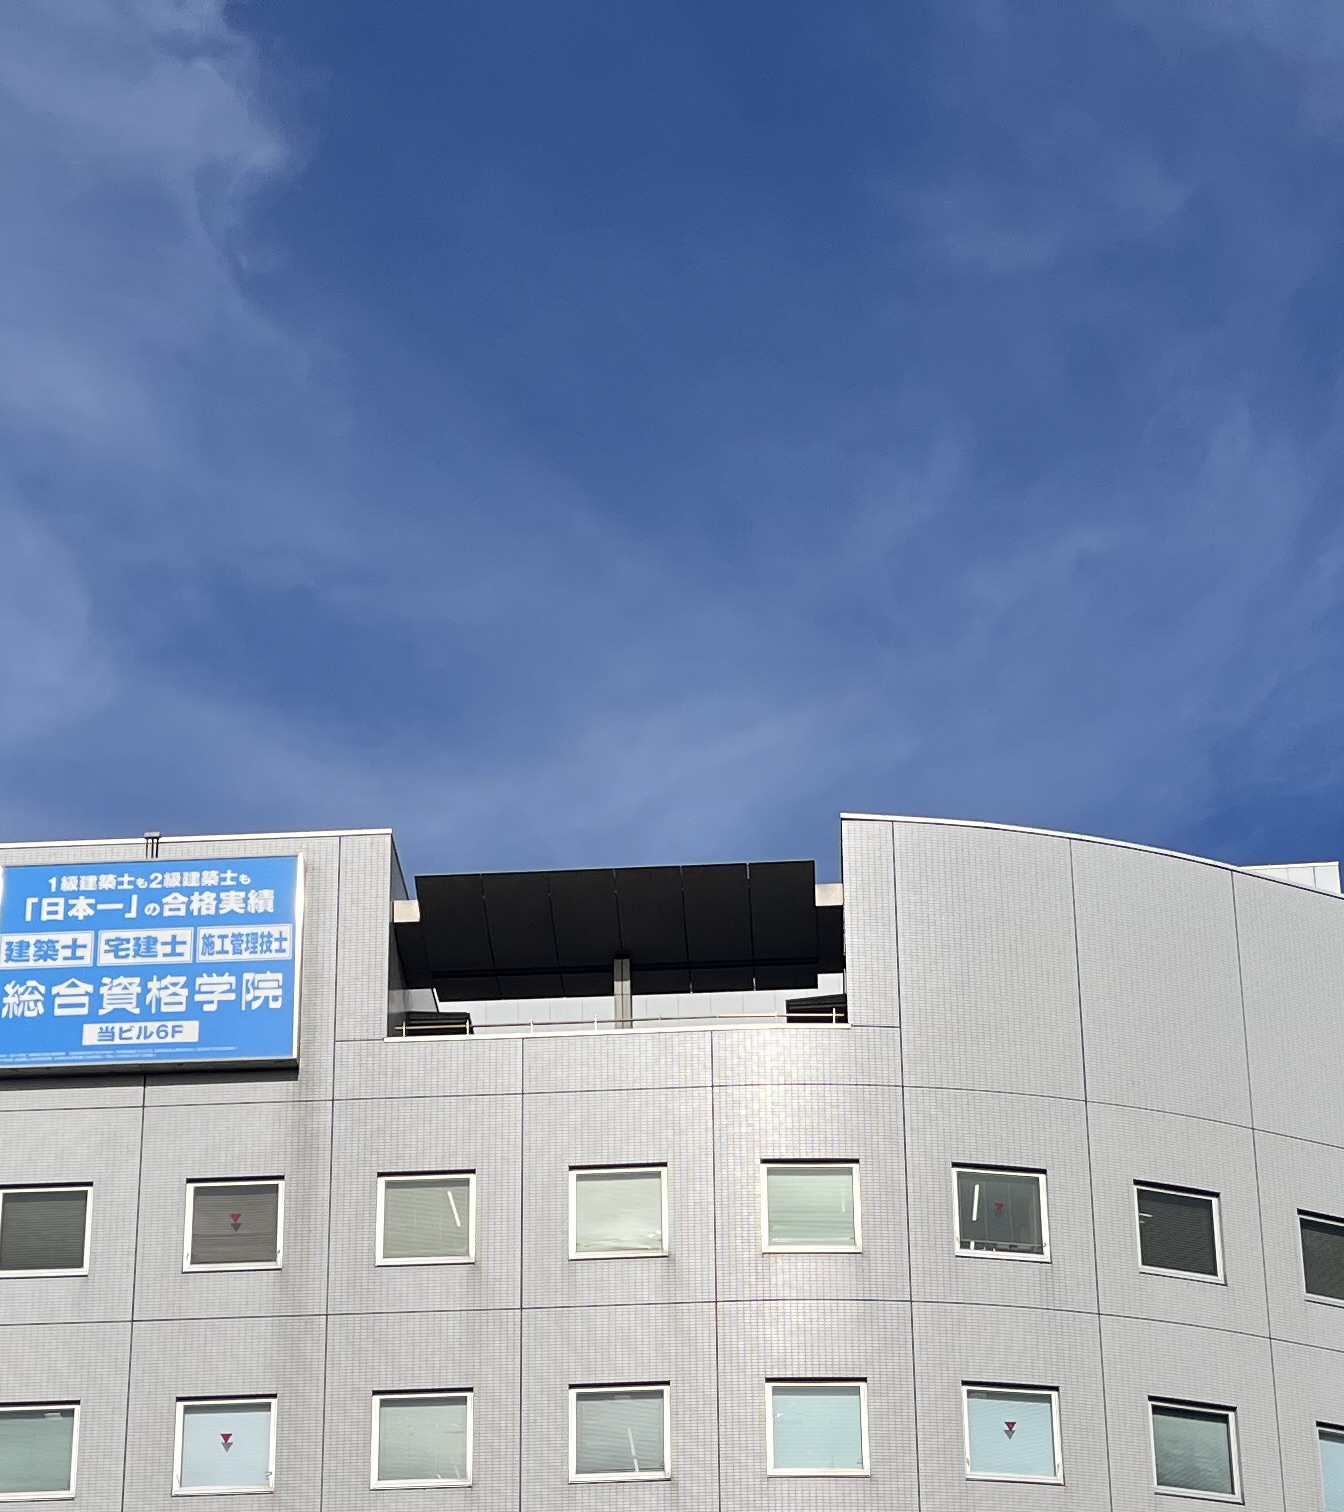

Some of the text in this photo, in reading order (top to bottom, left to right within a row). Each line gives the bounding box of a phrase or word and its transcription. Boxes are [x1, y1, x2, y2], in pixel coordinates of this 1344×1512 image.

[24, 889, 275, 922] 「日本一」の合格実績
[4, 931, 288, 963] 建築士 宅建士 施工管理技士
[1, 971, 284, 1019] 総合資格学院
[97, 1024, 184, 1042] 当ビル6F
